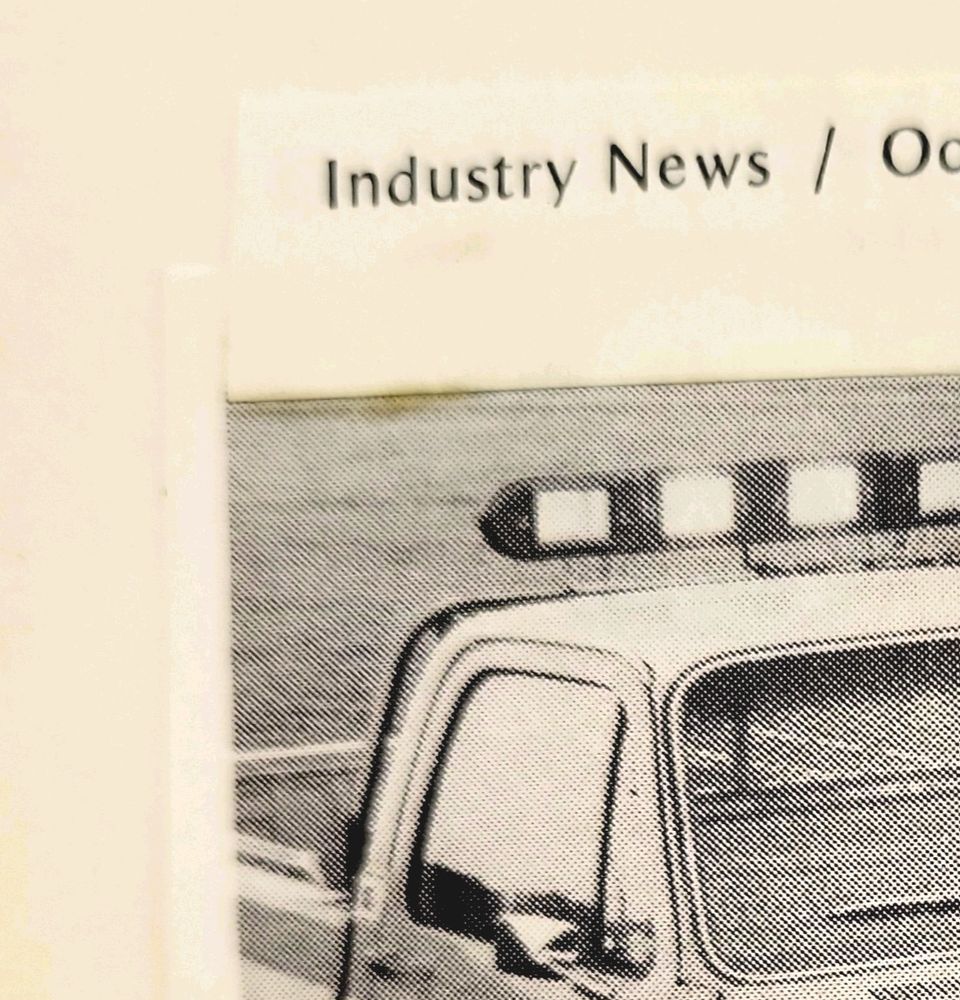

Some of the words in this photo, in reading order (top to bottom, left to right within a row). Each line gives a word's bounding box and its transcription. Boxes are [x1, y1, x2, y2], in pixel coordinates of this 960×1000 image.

[325, 154, 578, 211] Industry
[607, 139, 771, 195] News
[813, 124, 837, 195] /
